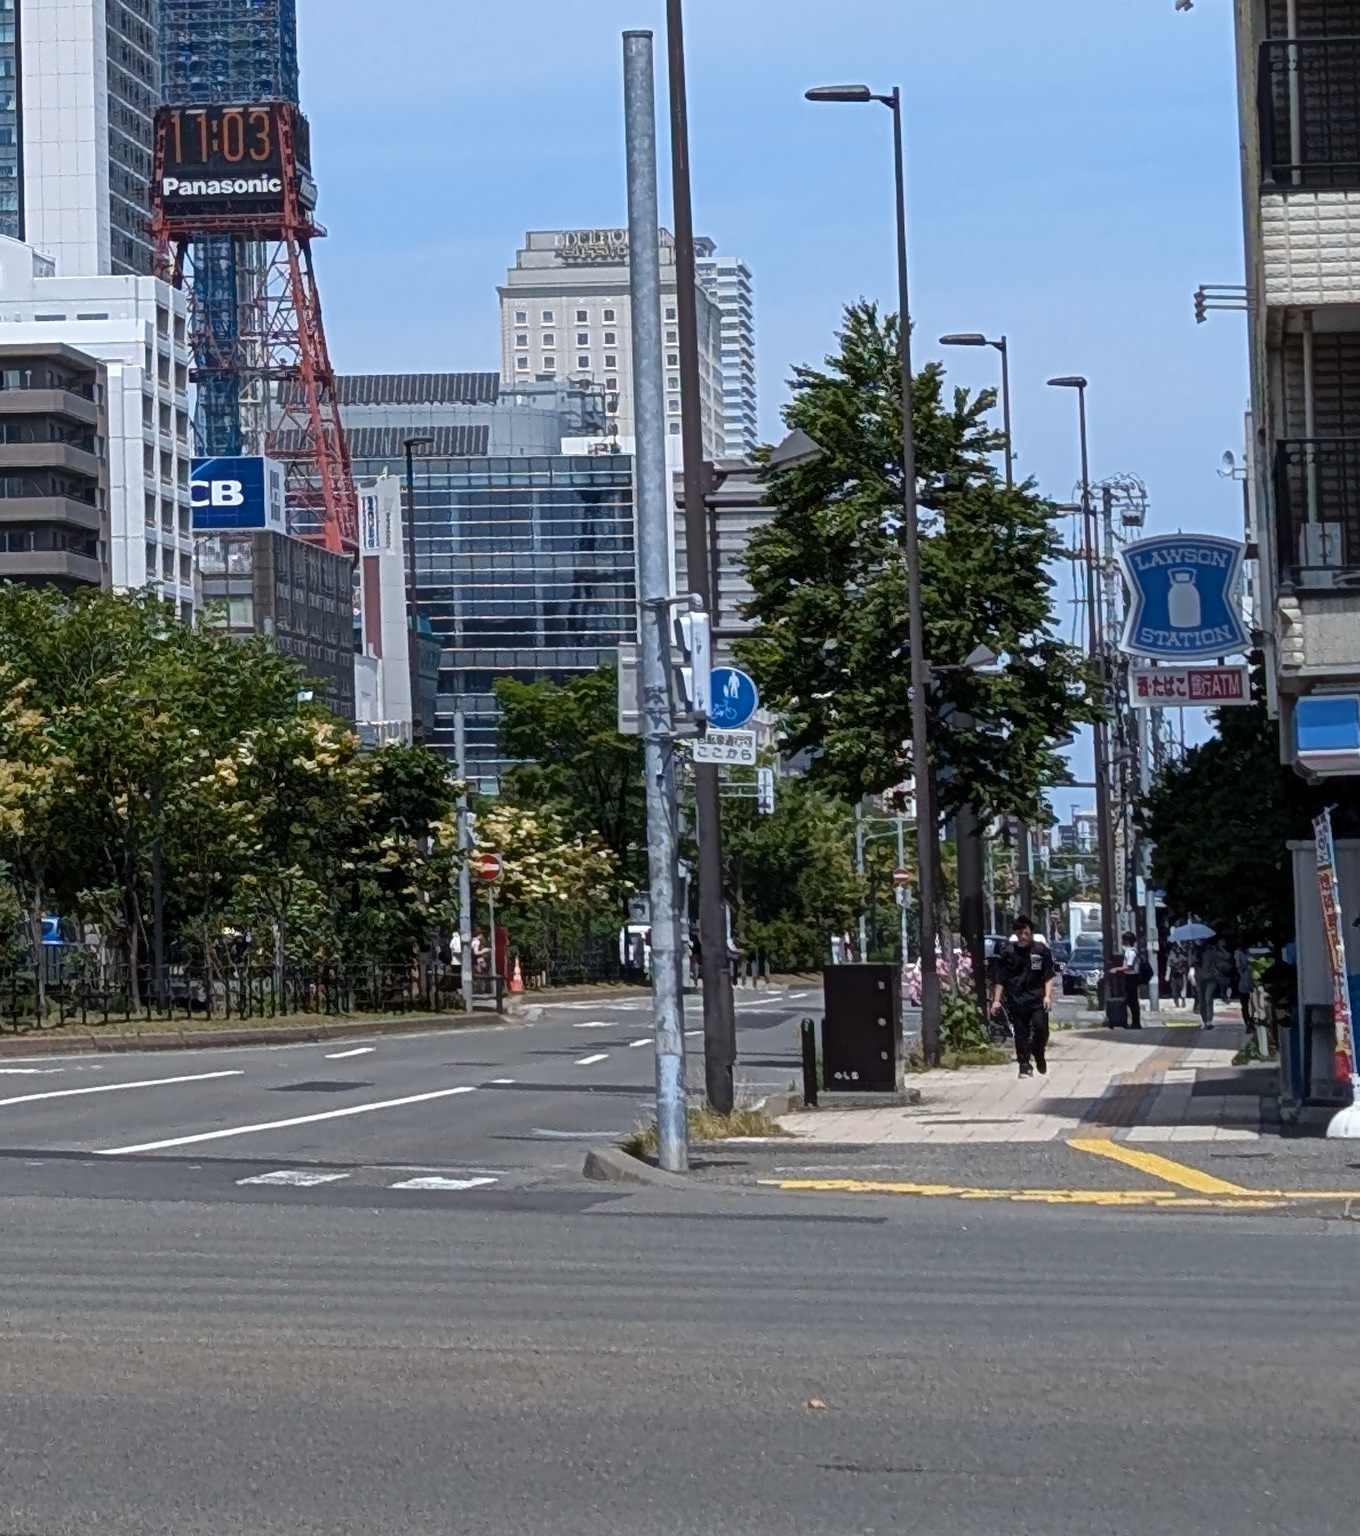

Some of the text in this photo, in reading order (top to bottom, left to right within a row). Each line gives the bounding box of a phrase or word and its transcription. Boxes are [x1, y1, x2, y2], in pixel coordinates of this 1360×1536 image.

[170, 110, 271, 163] 11:03
[162, 174, 282, 196] Panasonic
[189, 480, 245, 507] CB
[1135, 548, 1228, 571] LAWSON
[1140, 624, 1233, 647] STATION
[697, 745, 752, 761] ここから
